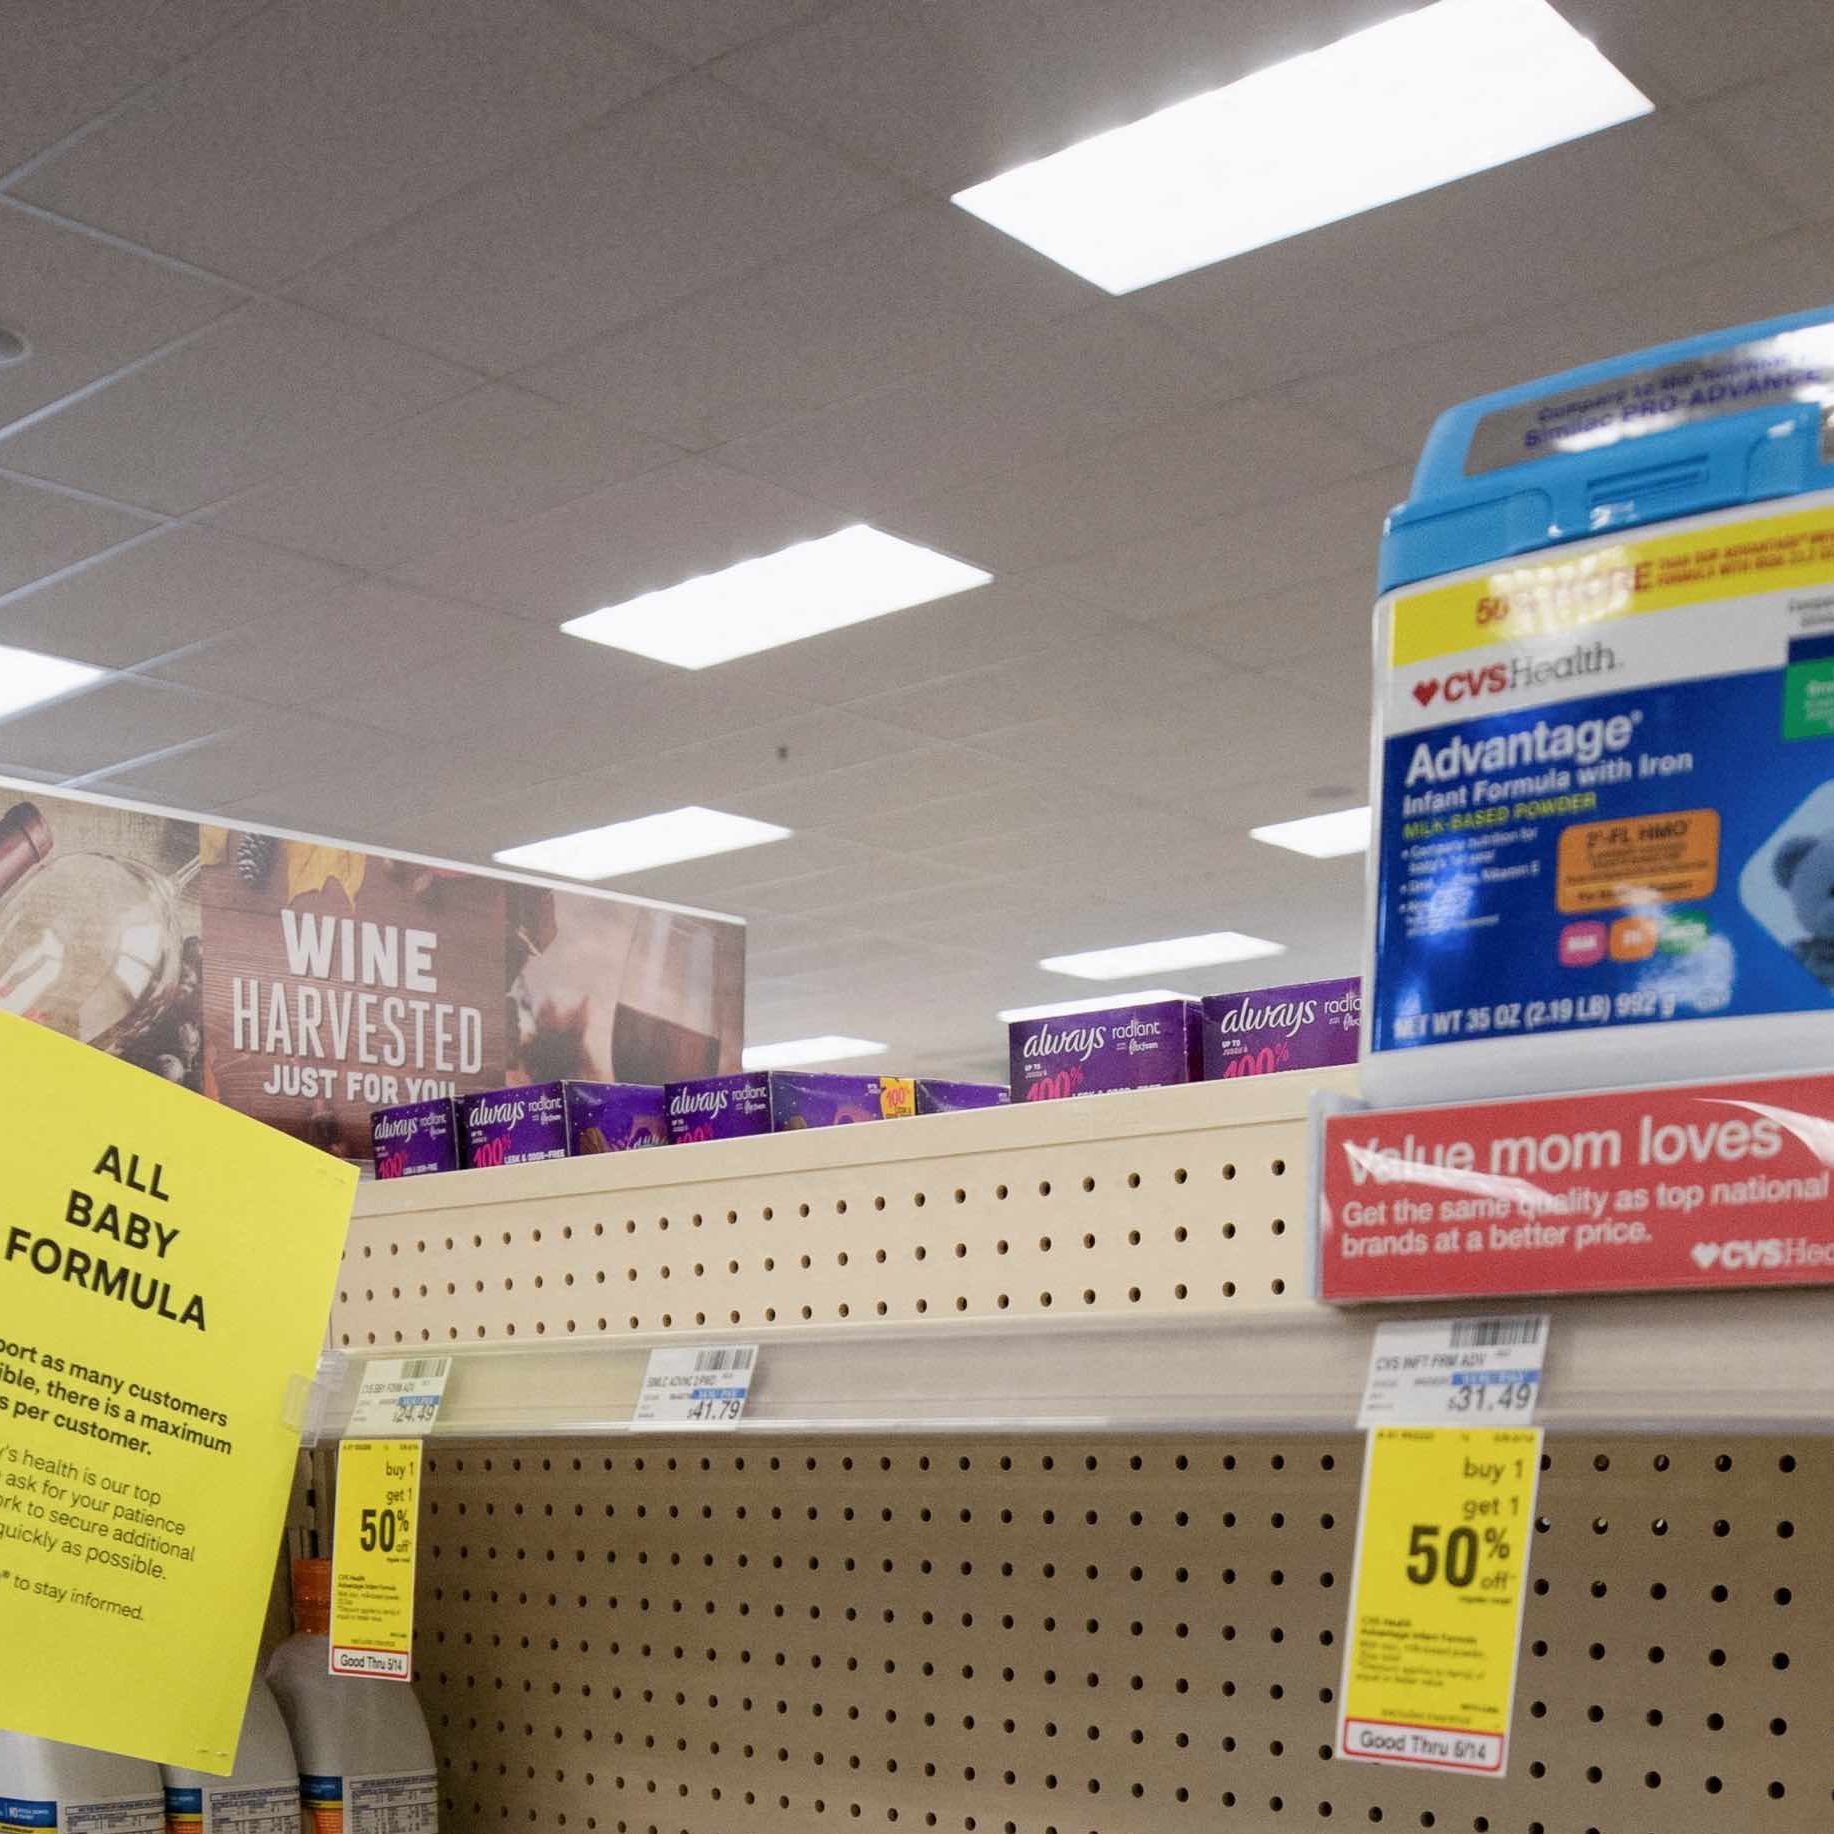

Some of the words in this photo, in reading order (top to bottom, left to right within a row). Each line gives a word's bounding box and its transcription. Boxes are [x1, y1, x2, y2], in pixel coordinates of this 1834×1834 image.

[1402, 789, 1468, 819] Infant
[1472, 768, 1571, 805] Formula
[1577, 755, 1633, 786] with
[1638, 747, 1696, 782] Iron
[279, 907, 440, 994] WINE
[230, 976, 484, 1076] HARVESTED
[1022, 1023, 1108, 1061] always
[1220, 996, 1318, 1038] always
[263, 1060, 339, 1100] JUST
[345, 1072, 401, 1106] FOR
[406, 1077, 457, 1104] YOU
[92, 1143, 170, 1203] ALL
[1343, 1135, 1475, 1188] Value
[1490, 1125, 1622, 1176] mom
[1638, 1113, 1784, 1166] loves
[64, 1188, 181, 1260] BABY
[1341, 1198, 1390, 1229] Get
[1393, 1194, 1435, 1223] the
[1439, 1194, 1510, 1221] same
[1515, 1182, 1609, 1220] quality
[1614, 1187, 1650, 1211] as
[1655, 1180, 1705, 1214] top
[1710, 1169, 1831, 1206] national
[1341, 1227, 1429, 1259] brands
[1434, 1225, 1461, 1252] at
[1466, 1230, 1483, 1251] a
[1489, 1219, 1568, 1250] better
[1575, 1216, 1653, 1250] price.
[3, 1225, 207, 1333] FORMULA
[40, 1352, 66, 1374] as
[68, 1362, 125, 1395] many
[127, 1381, 230, 1428] customers
[46, 1379, 101, 1412] there
[103, 1398, 121, 1419] is
[123, 1407, 137, 1424] a
[139, 1412, 234, 1456] maximum
[12, 1399, 50, 1424] per
[52, 1412, 153, 1457] customer.
[4, 1470, 38, 1494] ask
[40, 1478, 69, 1501] for
[69, 1490, 112, 1515] your
[112, 1502, 187, 1537] patience
[21, 1448, 80, 1483] health
[81, 1468, 98, 1487] is
[100, 1476, 132, 1497] our
[133, 1482, 163, 1508] top
[26, 1502, 47, 1520] to
[48, 1508, 110, 1538] secure
[111, 1525, 197, 1564] additional
[60, 1538, 84, 1558] as
[84, 1543, 169, 1582] possible.
[12, 1573, 32, 1592] to
[33, 1578, 69, 1604] stay
[69, 1586, 146, 1622] informed.
